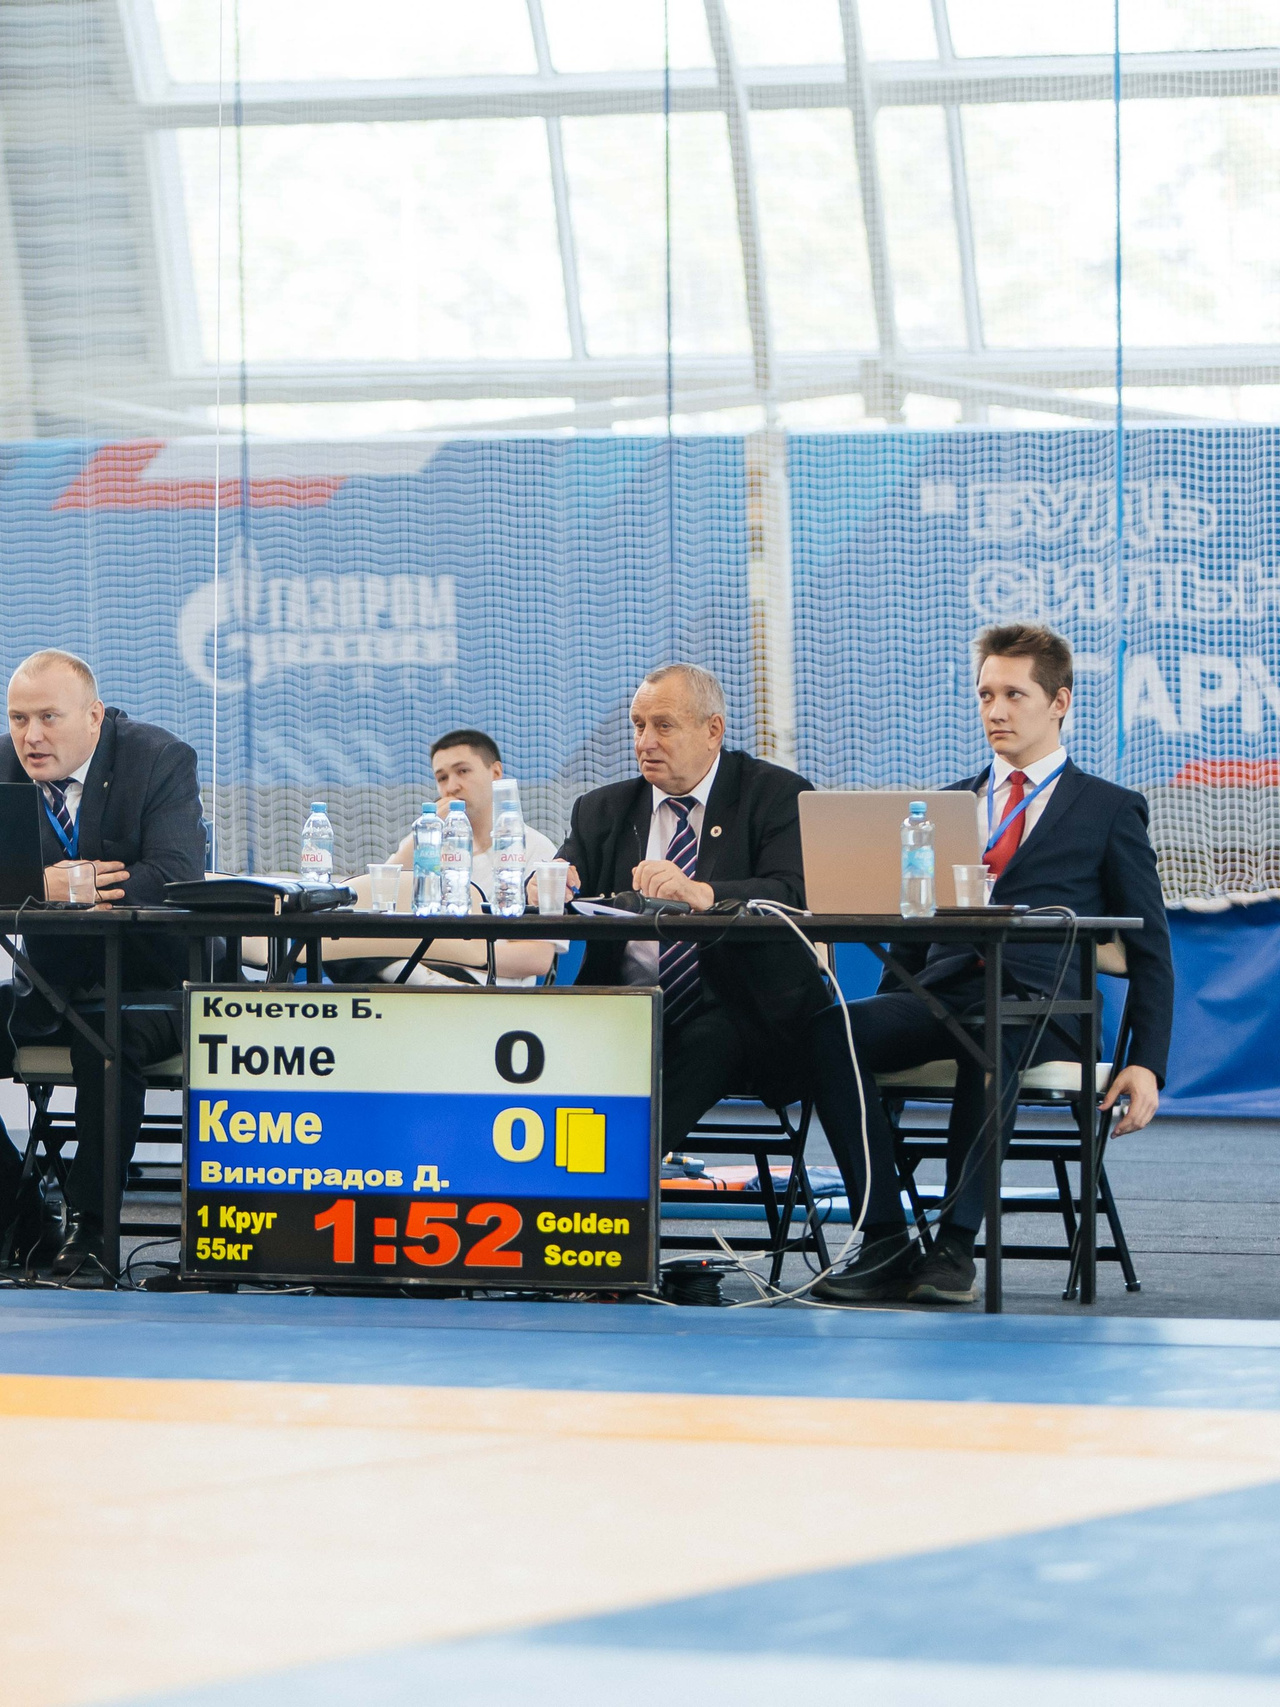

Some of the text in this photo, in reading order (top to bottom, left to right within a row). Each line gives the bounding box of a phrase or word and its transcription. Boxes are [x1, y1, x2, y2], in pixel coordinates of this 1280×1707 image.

[268, 574, 457, 628] ГАЗПРОМ
[204, 997, 381, 1018] Кочетов Б.
[199, 1034, 335, 1076] Тюме
[495, 1031, 544, 1084] 0
[200, 1100, 322, 1144] Кеме
[493, 1108, 544, 1162] 0
[201, 1161, 449, 1191] Виноградов Д.
[198, 1206, 277, 1234] 1 Круг
[315, 1200, 522, 1267] 1:52
[537, 1212, 629, 1234] Golden
[197, 1238, 253, 1260] 55кг
[544, 1245, 621, 1267] Score
